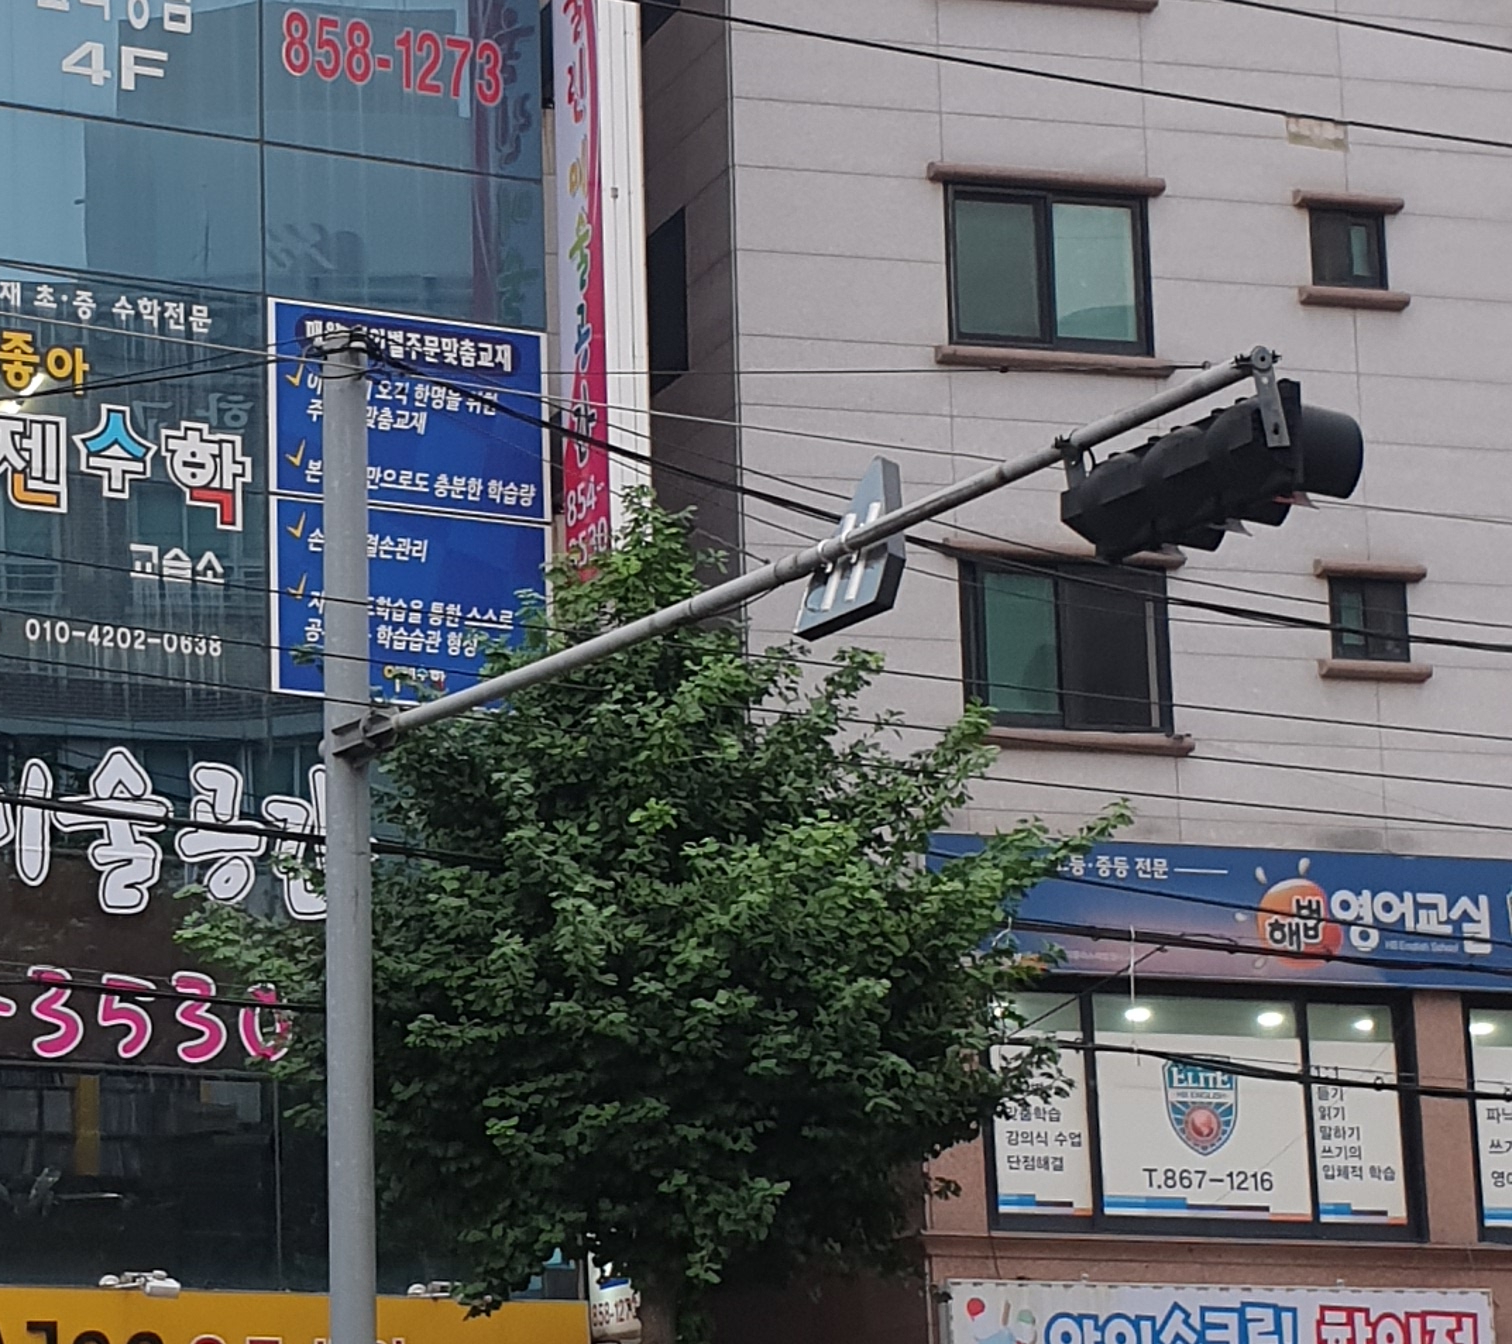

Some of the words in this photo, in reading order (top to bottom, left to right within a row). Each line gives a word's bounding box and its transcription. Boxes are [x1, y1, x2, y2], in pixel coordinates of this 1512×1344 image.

[61, 42, 169, 91] 4F
[281, 11, 504, 106] 858-1273
[111, 295, 213, 335] 수학전문
[434, 474, 483, 503] 충분한
[487, 477, 536, 508] 학습량
[129, 543, 226, 586] 교습소
[25, 618, 224, 657] 010-4202-0638
[376, 625, 442, 654] 학습습관
[1135, 858, 1168, 879] 전문
[1330, 889, 1492, 955] 영어교실
[1171, 1066, 1231, 1089] ELITE
[1318, 1105, 1345, 1121] 읽기
[1054, 1131, 1082, 1148] 수업
[1319, 1125, 1361, 1141] 말하기
[1320, 1145, 1362, 1161] 쓰기의
[1322, 1164, 1364, 1181] 입체적
[1369, 1164, 1396, 1182] 학습
